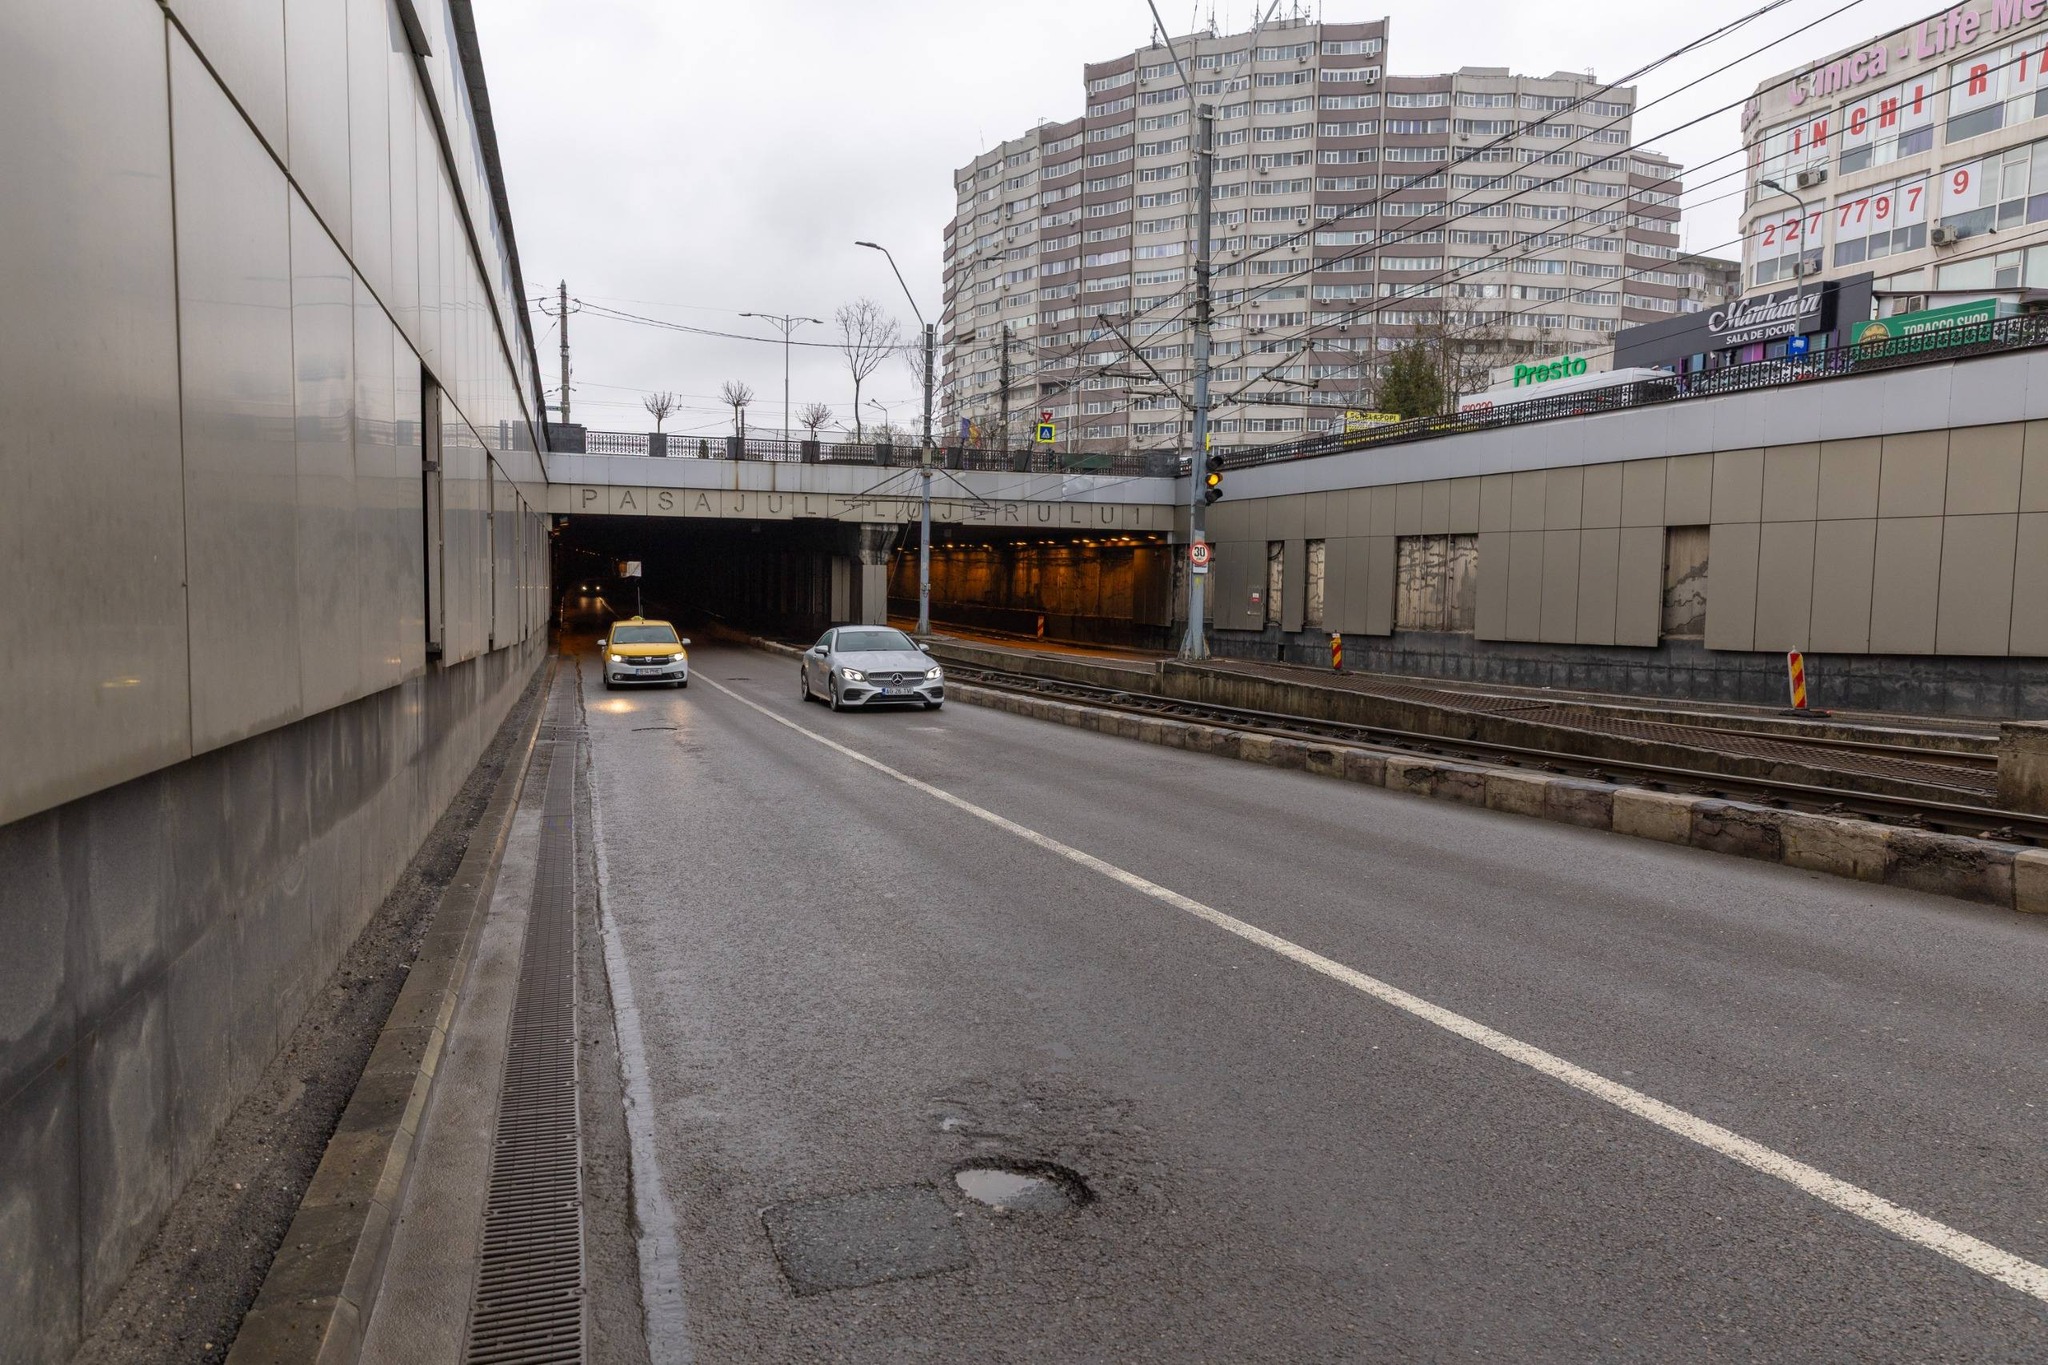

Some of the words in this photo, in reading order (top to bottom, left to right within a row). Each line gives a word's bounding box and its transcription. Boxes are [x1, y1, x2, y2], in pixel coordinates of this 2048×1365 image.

[1917, 7, 1980, 59] Life
[1708, 293, 1821, 332] Manhattan
[1726, 332, 1749, 345] SALA
[1750, 329, 1763, 341] DE
[1764, 323, 1796, 338] JOCUR
[1513, 356, 1587, 388] Presto
[582, 489, 816, 515] PASAJUL
[875, 499, 1139, 525] LUJERULUI
[1194, 547, 1205, 557] 30
